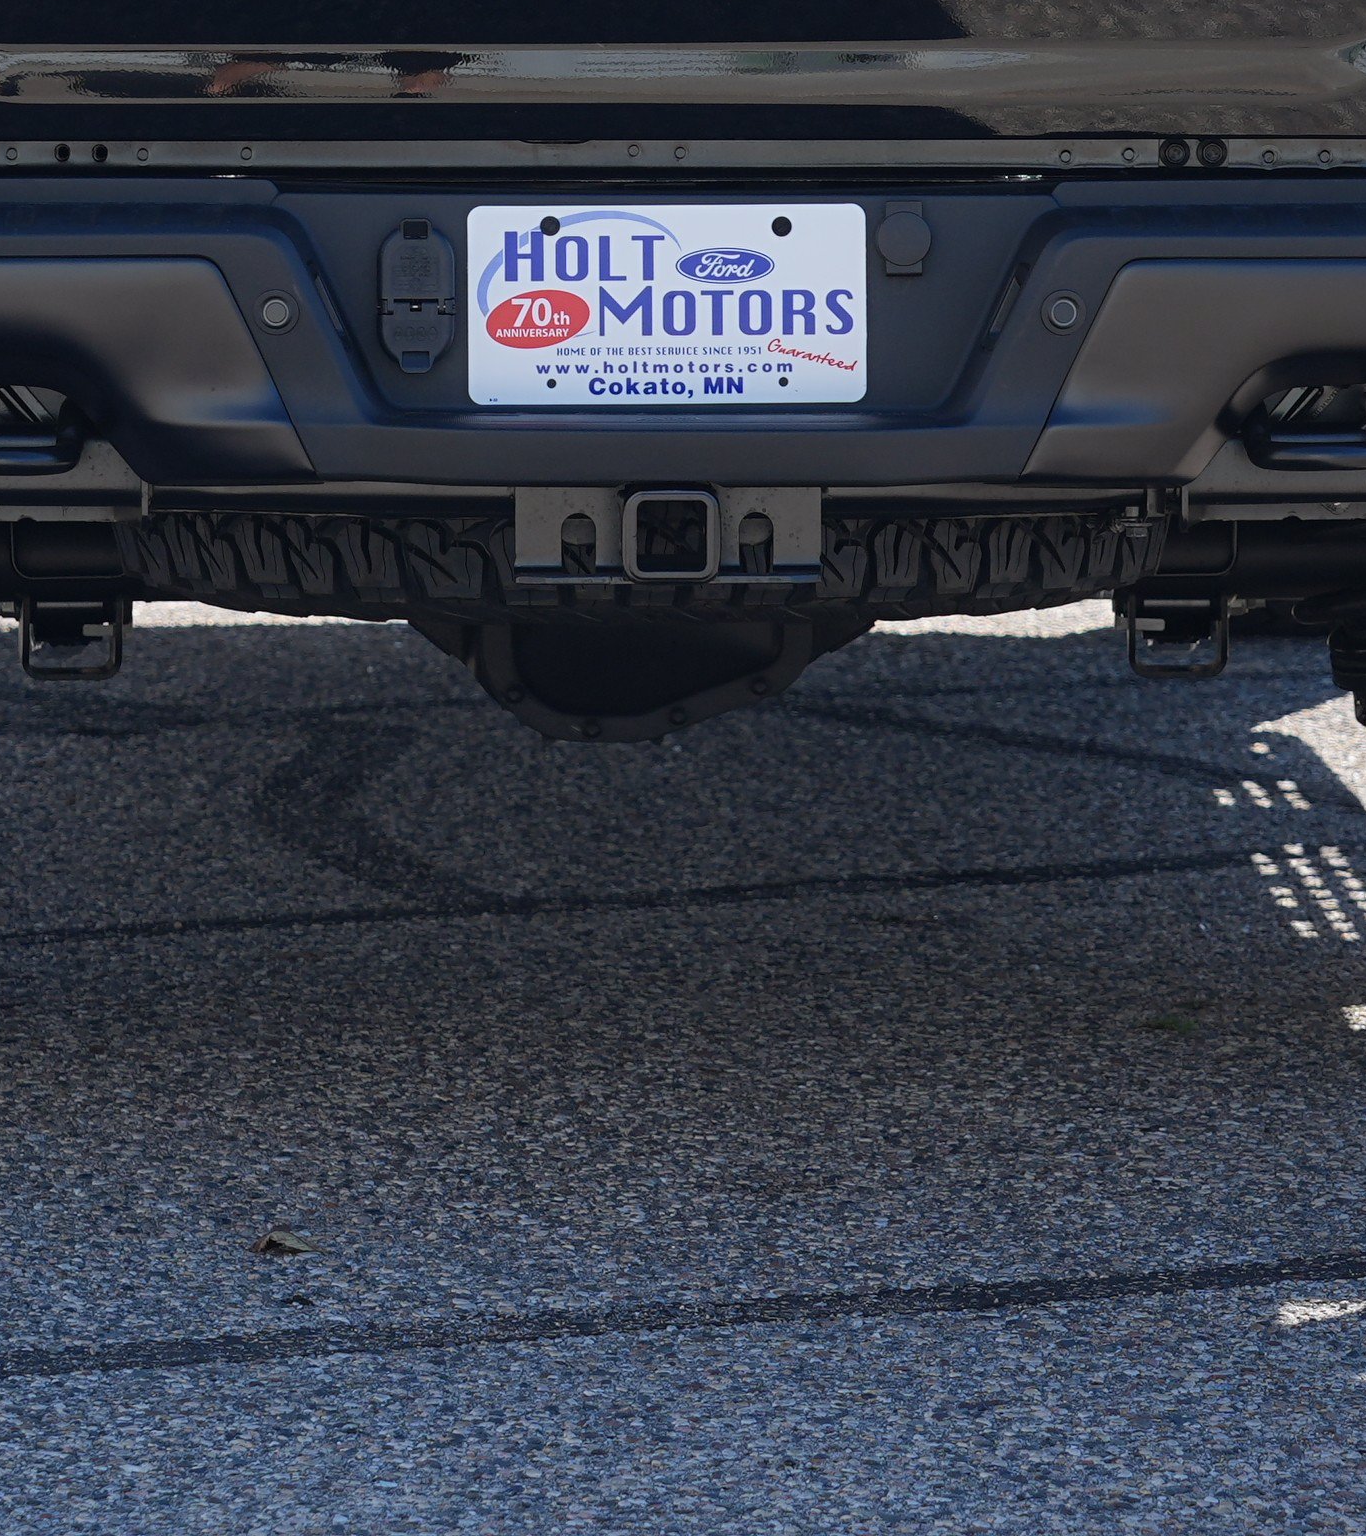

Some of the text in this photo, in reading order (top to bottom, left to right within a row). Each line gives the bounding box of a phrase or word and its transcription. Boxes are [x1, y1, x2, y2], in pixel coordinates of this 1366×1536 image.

[504, 230, 665, 282] HOLT
[695, 252, 755, 278] Ford
[511, 297, 571, 327] 70th
[599, 285, 854, 337] MOTORS
[495, 328, 570, 338] ANNIVERSARY
[556, 347, 586, 357] HOME
[590, 347, 602, 356] OF
[606, 347, 624, 356] THE
[628, 346, 652, 356] BEST
[702, 346, 733, 355] SINCE
[738, 346, 763, 355] 1951
[767, 338, 858, 372] Guaranteed
[536, 361, 794, 375] www.holtmotors.com
[588, 377, 744, 399] Cokato, MN
